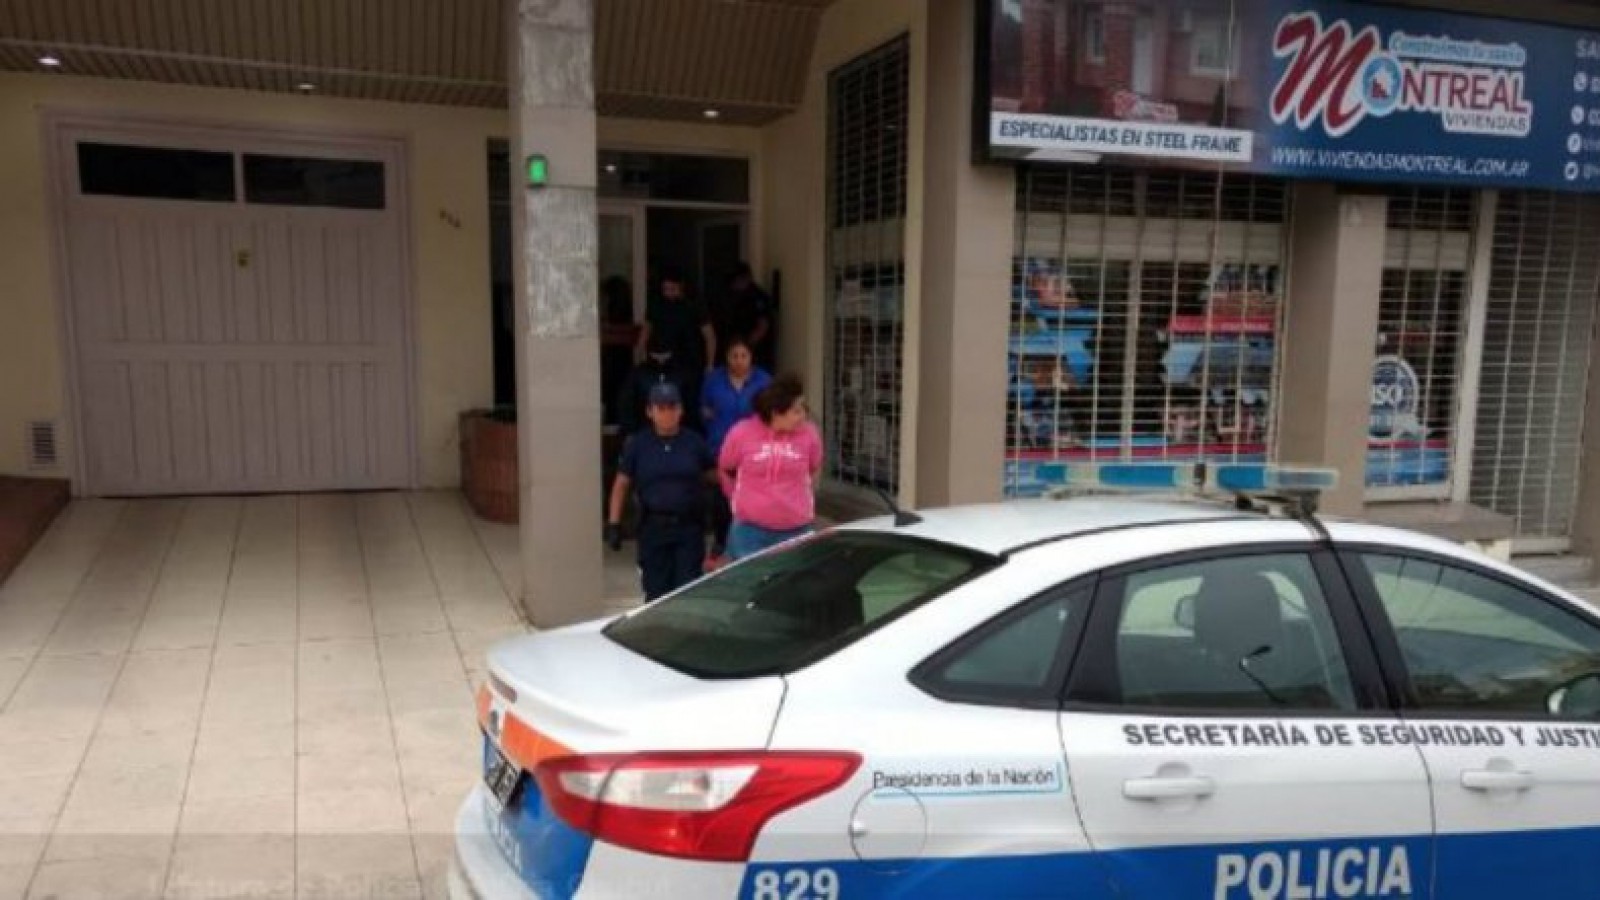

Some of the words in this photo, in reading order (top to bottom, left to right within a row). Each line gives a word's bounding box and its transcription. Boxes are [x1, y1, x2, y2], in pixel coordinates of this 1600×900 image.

[999, 119, 1118, 146] ESPECIALISTAS
[1121, 128, 1141, 146] EN
[1146, 130, 1187, 149] STEEL
[1191, 134, 1242, 153] FRAME
[1446, 112, 1527, 132] VIVIENDAS
[1271, 147, 1530, 177] WWW.VIVIENDASMONTREAL.COM.AR
[1314, 724, 1353, 746] DE
[1357, 724, 1505, 747] SEGURIDAD
[1507, 725, 1525, 747] Y
[873, 769, 962, 790] Presidencia
[964, 768, 984, 786] de
[987, 769, 1000, 785] la
[1003, 767, 1055, 785] Nación
[753, 867, 838, 900] 829
[1214, 844, 1412, 900] POLICIA
